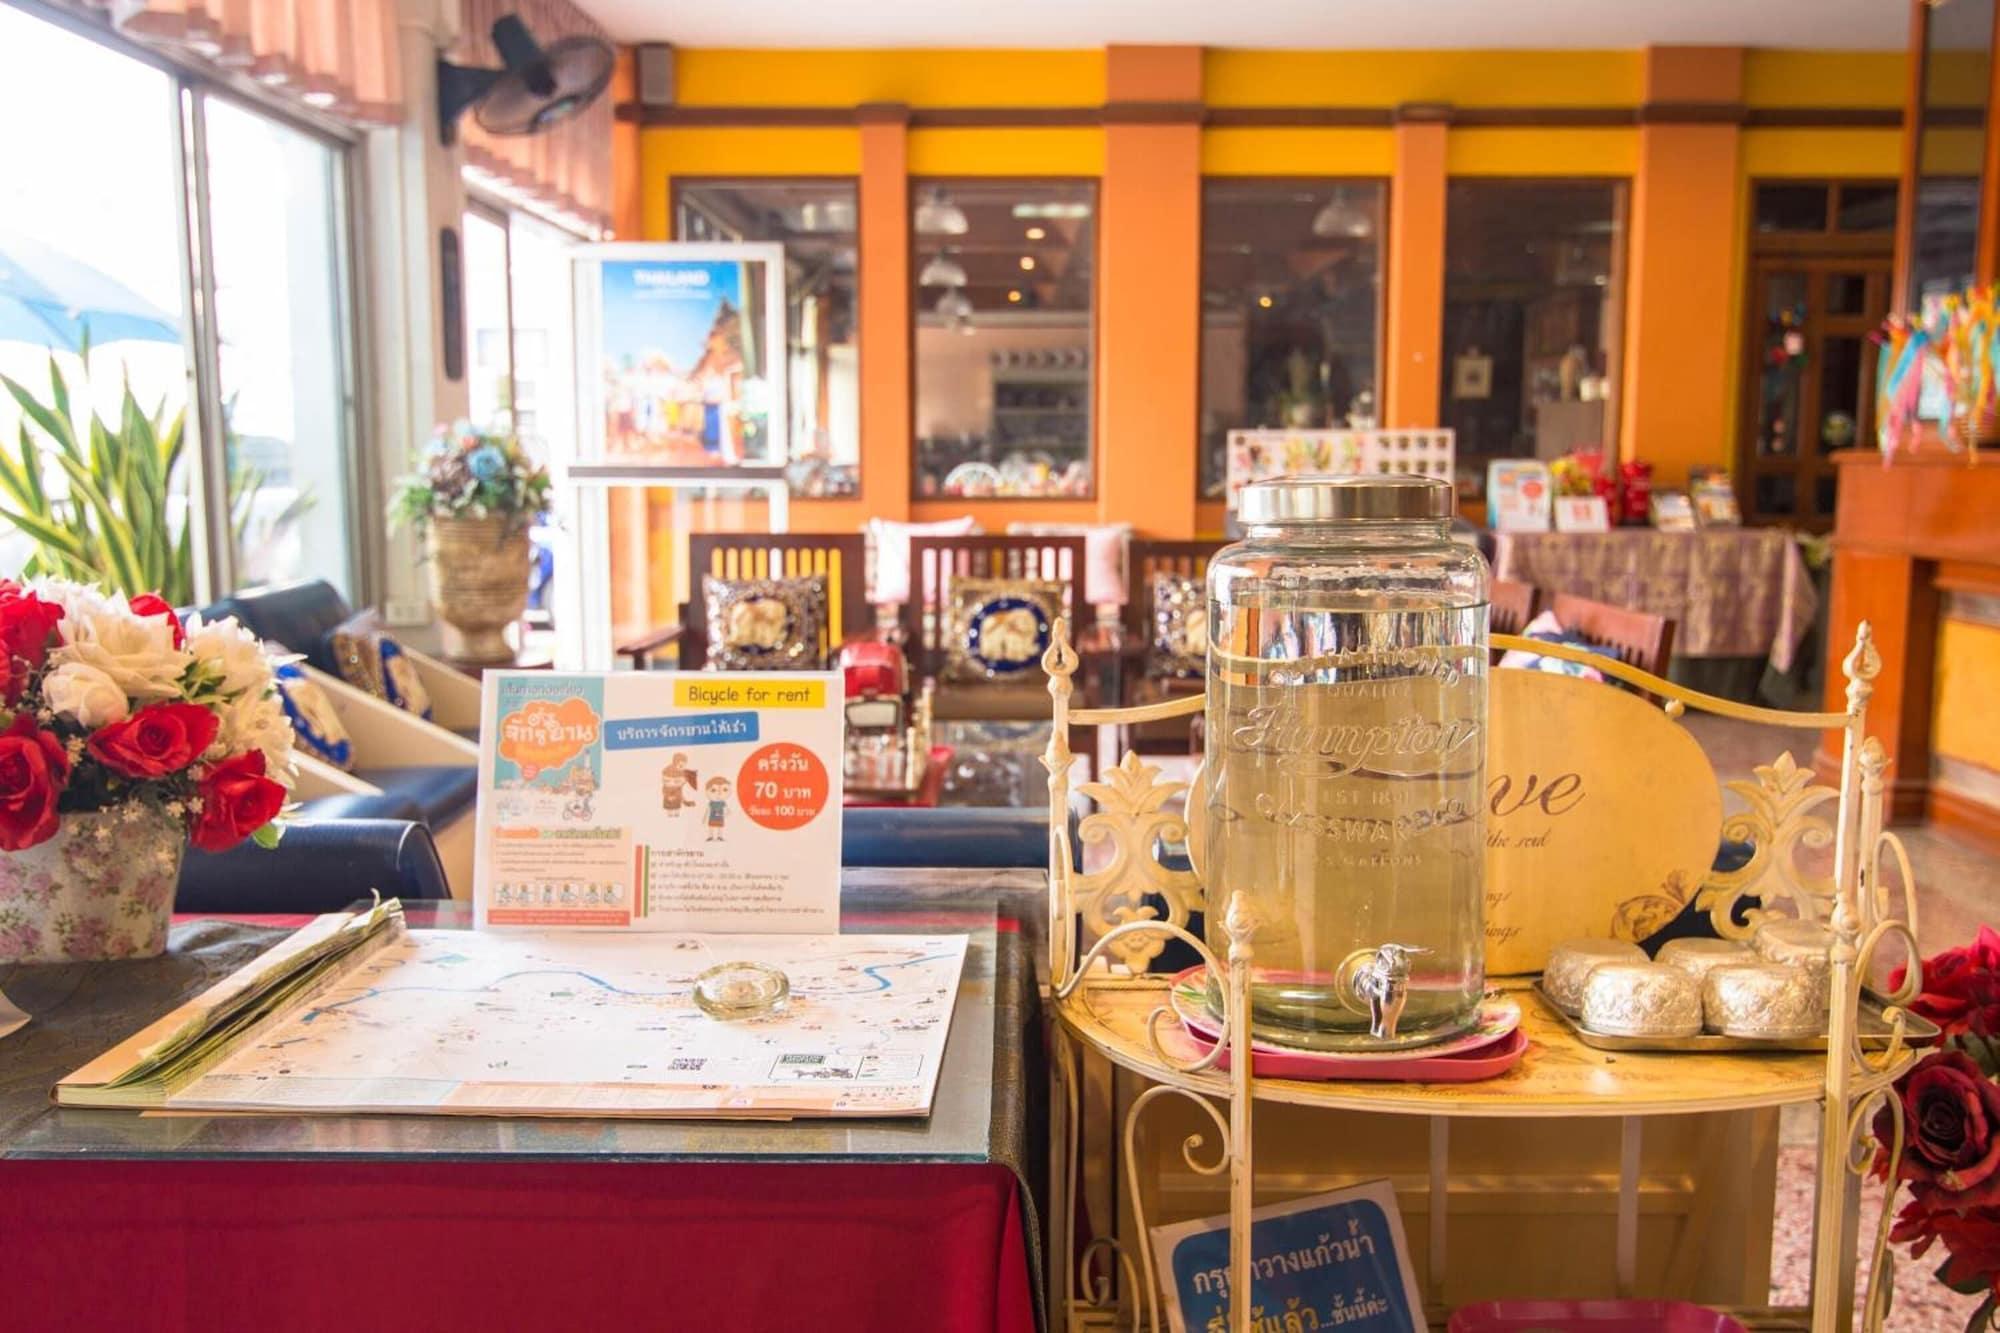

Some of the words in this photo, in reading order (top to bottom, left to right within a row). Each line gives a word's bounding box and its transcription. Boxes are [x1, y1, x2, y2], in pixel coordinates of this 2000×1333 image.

[688, 686, 739, 705] Bicycle
[747, 686, 770, 702] for
[777, 687, 811, 702] rent
[753, 781, 779, 799] 70
[782, 787, 812, 800] บาท
[775, 805, 796, 816] 100
